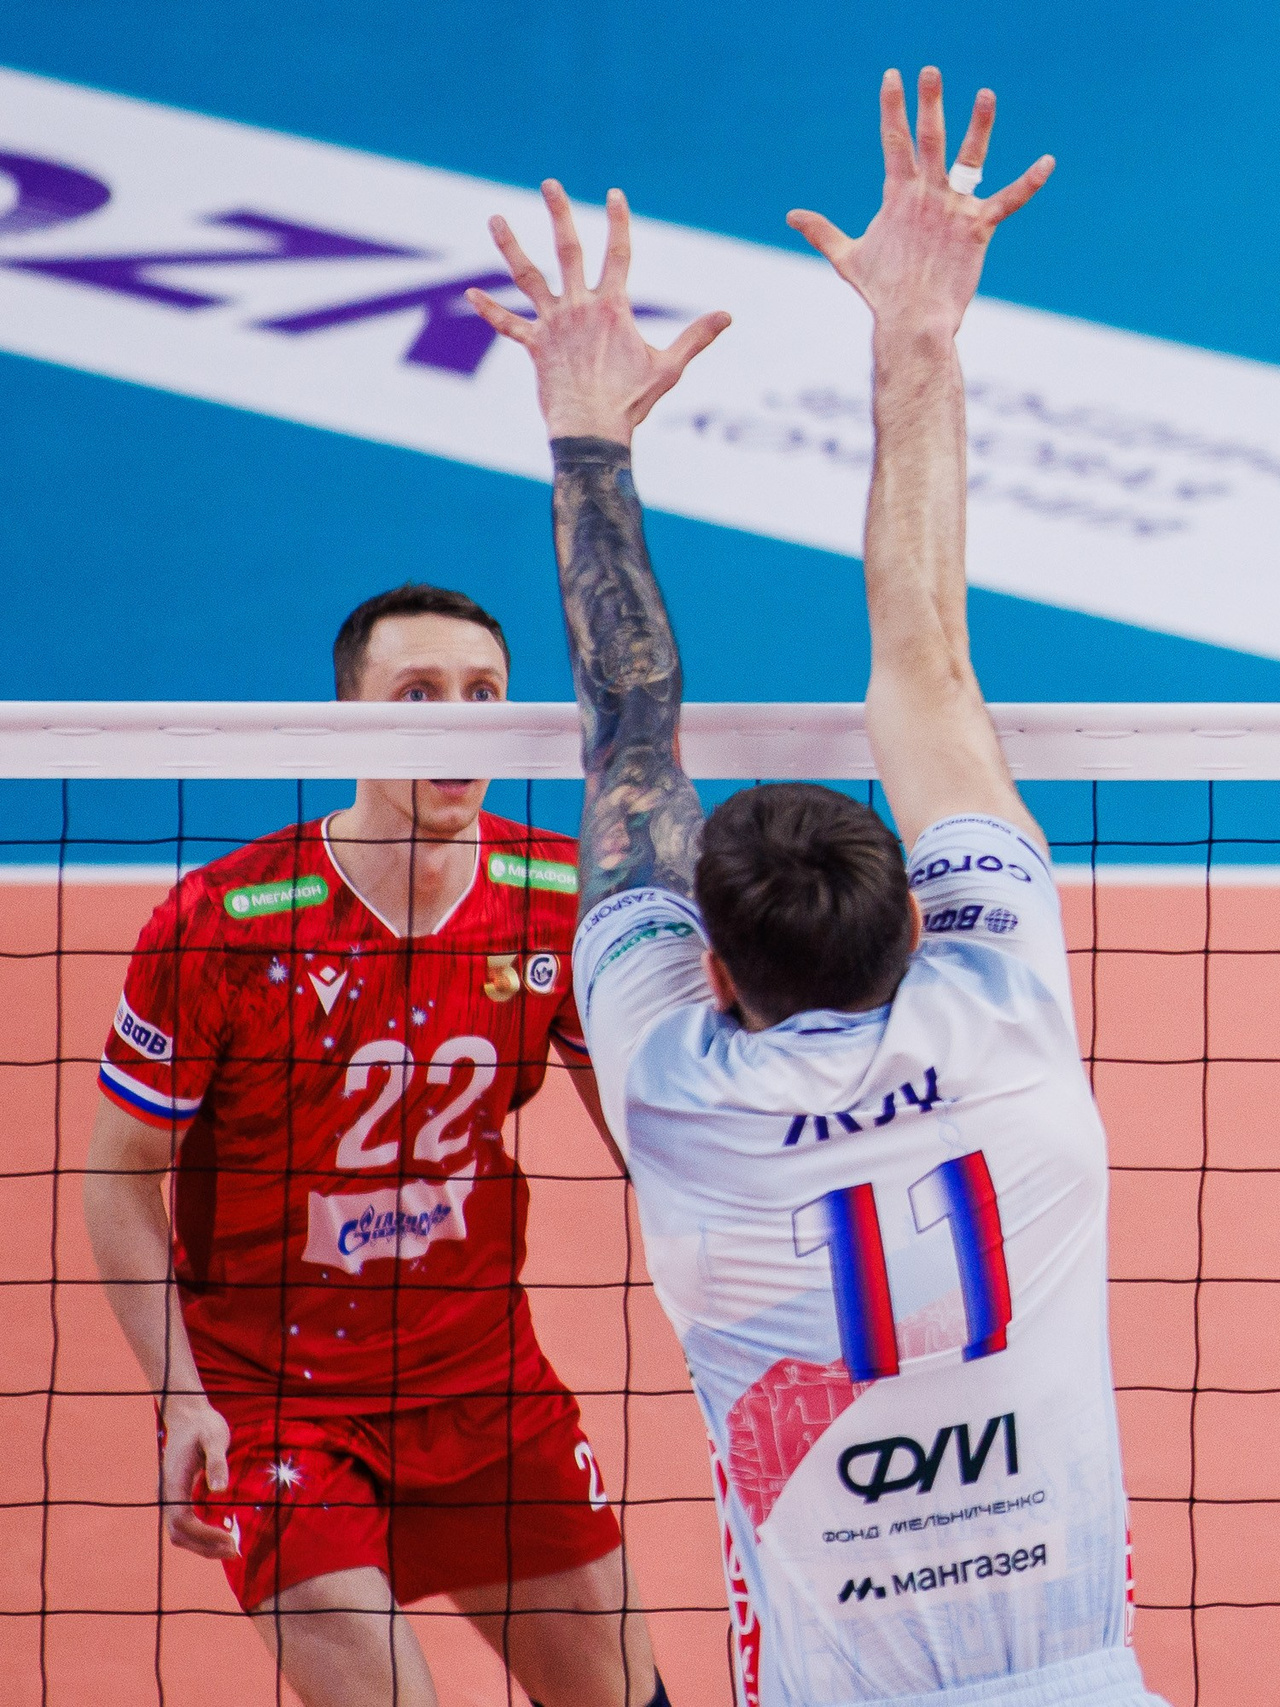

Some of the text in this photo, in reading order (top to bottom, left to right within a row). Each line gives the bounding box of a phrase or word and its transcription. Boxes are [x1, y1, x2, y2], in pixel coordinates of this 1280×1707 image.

[922, 905, 984, 934] ВФ
[121, 1012, 167, 1055] ВФВ
[335, 1036, 498, 1169] 22
[792, 1150, 1012, 1382] 11
[822, 1490, 1045, 1542] ФОНД МЕЛЬНИЧЕНКО
[892, 1543, 1047, 1596] мангазея
